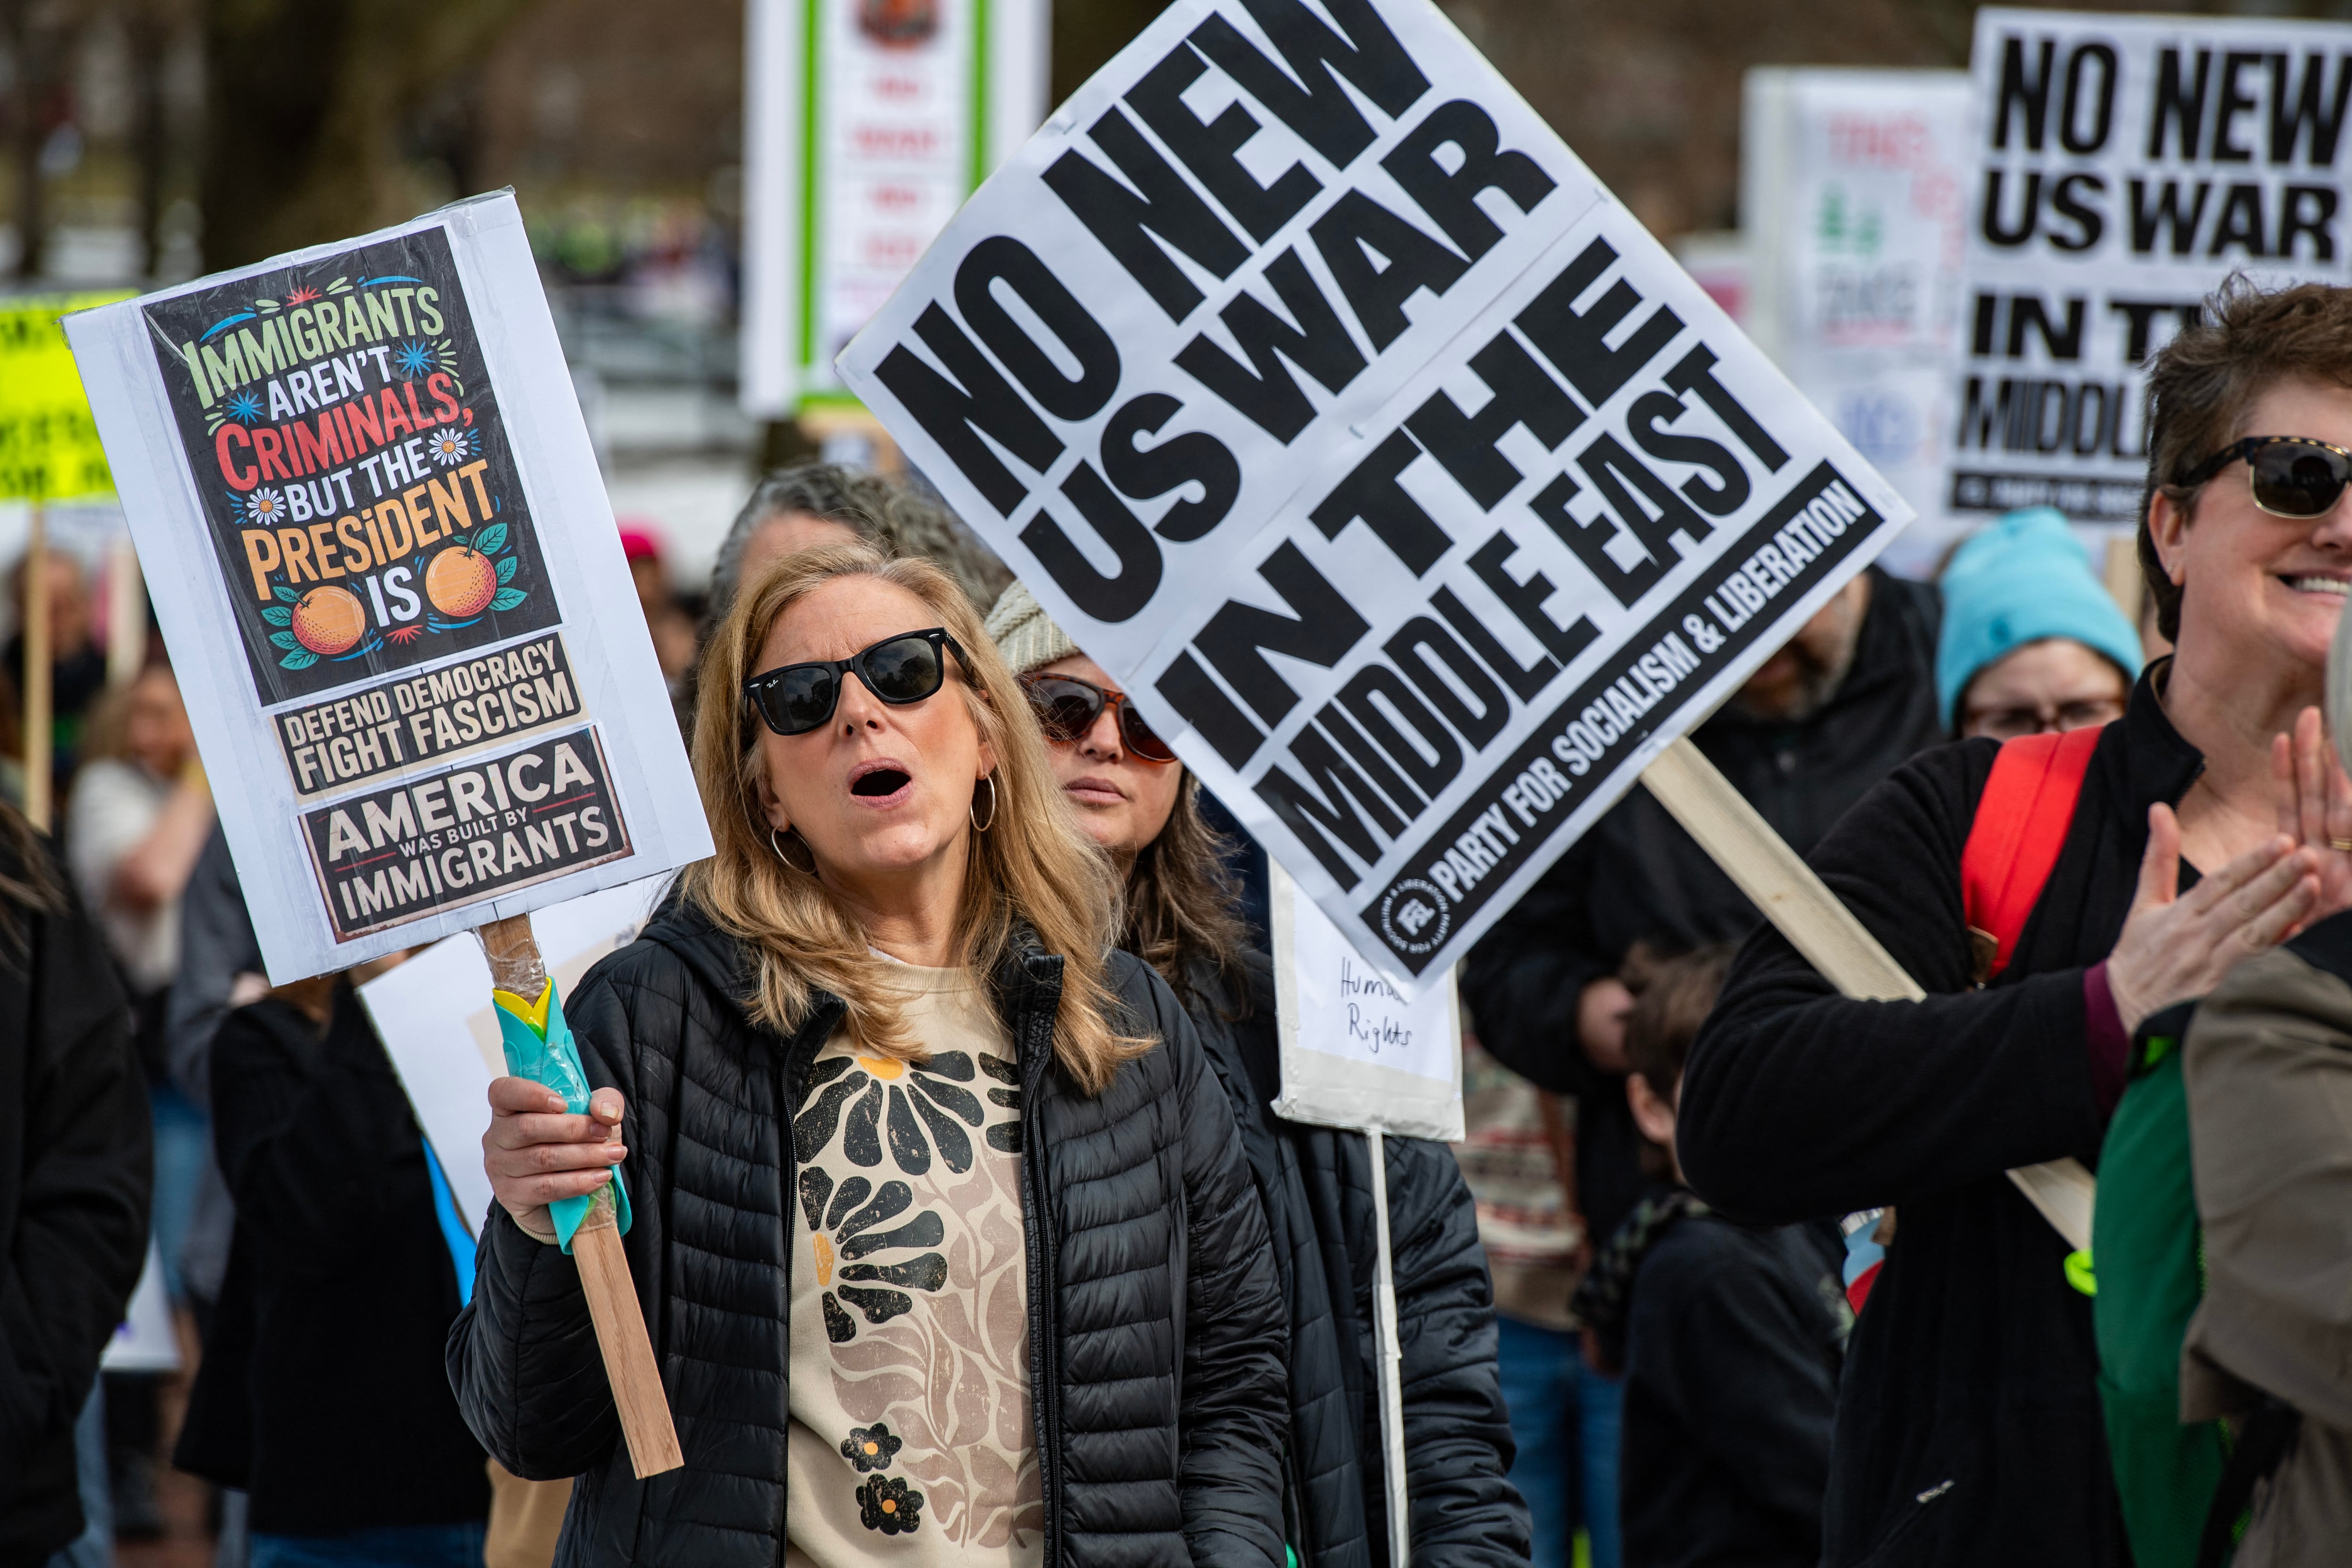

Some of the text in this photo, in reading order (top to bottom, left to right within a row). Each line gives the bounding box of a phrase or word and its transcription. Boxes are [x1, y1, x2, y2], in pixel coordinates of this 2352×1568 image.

[1994, 38, 2118, 154] NO
[2148, 47, 2352, 164] NEW
[874, 0, 1431, 519] NO NEW
[1984, 170, 2106, 251] US
[2127, 179, 2339, 260] WAR
[182, 286, 444, 409] IMMIGRANTS
[1018, 100, 1557, 623] US WAR
[1974, 294, 2086, 359] IN
[215, 373, 473, 491] CRIMINALS,
[267, 346, 391, 422] AREN'T
[1960, 379, 2150, 457] MIDDL
[284, 437, 431, 522] BUT THE
[1154, 236, 1685, 772] IN THE
[365, 566, 421, 627] IS
[1252, 342, 1790, 893] MIDDLE EAST
[284, 639, 556, 748] DEFEND DEMOCRACY
[294, 671, 574, 789] FIGHT FASCISM
[1428, 479, 1866, 902] PARTY FOR SOCIALISM & LIBERATION
[329, 742, 595, 862] AMERICA
[399, 806, 528, 857] WAS BUILT BY
[339, 806, 609, 920] IMMIGRANTS
[1341, 956, 1400, 1000] Huma
[1347, 1003, 1412, 1055] Rights
